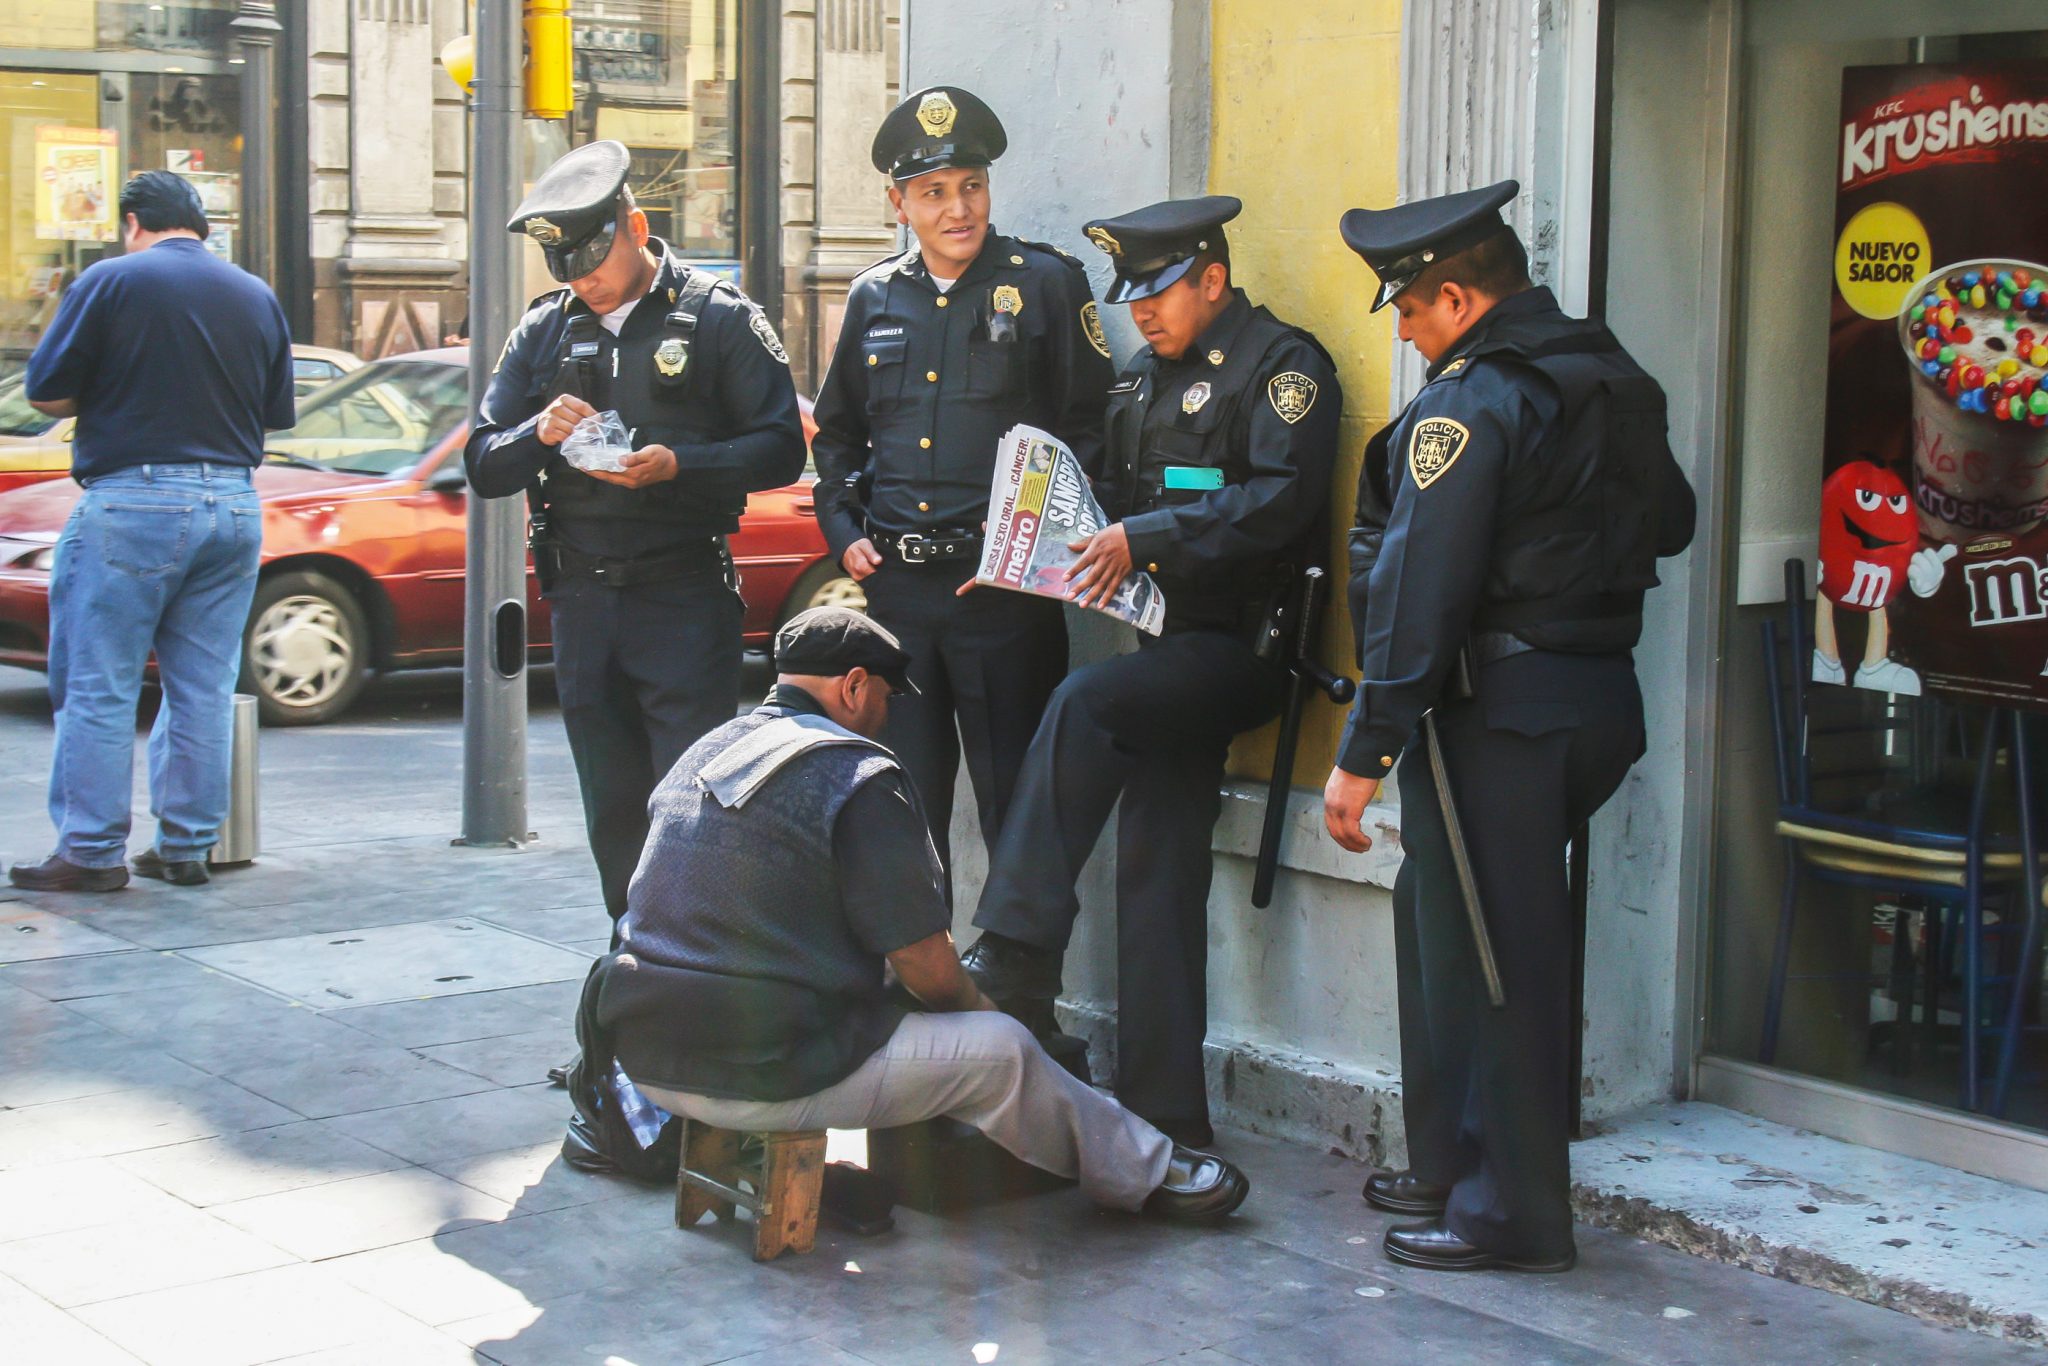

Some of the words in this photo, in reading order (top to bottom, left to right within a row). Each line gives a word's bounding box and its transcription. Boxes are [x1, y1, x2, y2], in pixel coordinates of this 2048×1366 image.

[1873, 100, 1905, 119] KFC
[1849, 241, 1920, 262] NUEVO
[1848, 263, 1915, 283] SABOR
[1273, 374, 1314, 392] POLICIA
[1419, 422, 1462, 442] POLICIA
[1047, 454, 1082, 527] SANGRE
[994, 522, 1009, 548] SEXO
[1004, 517, 1034, 583] metro
